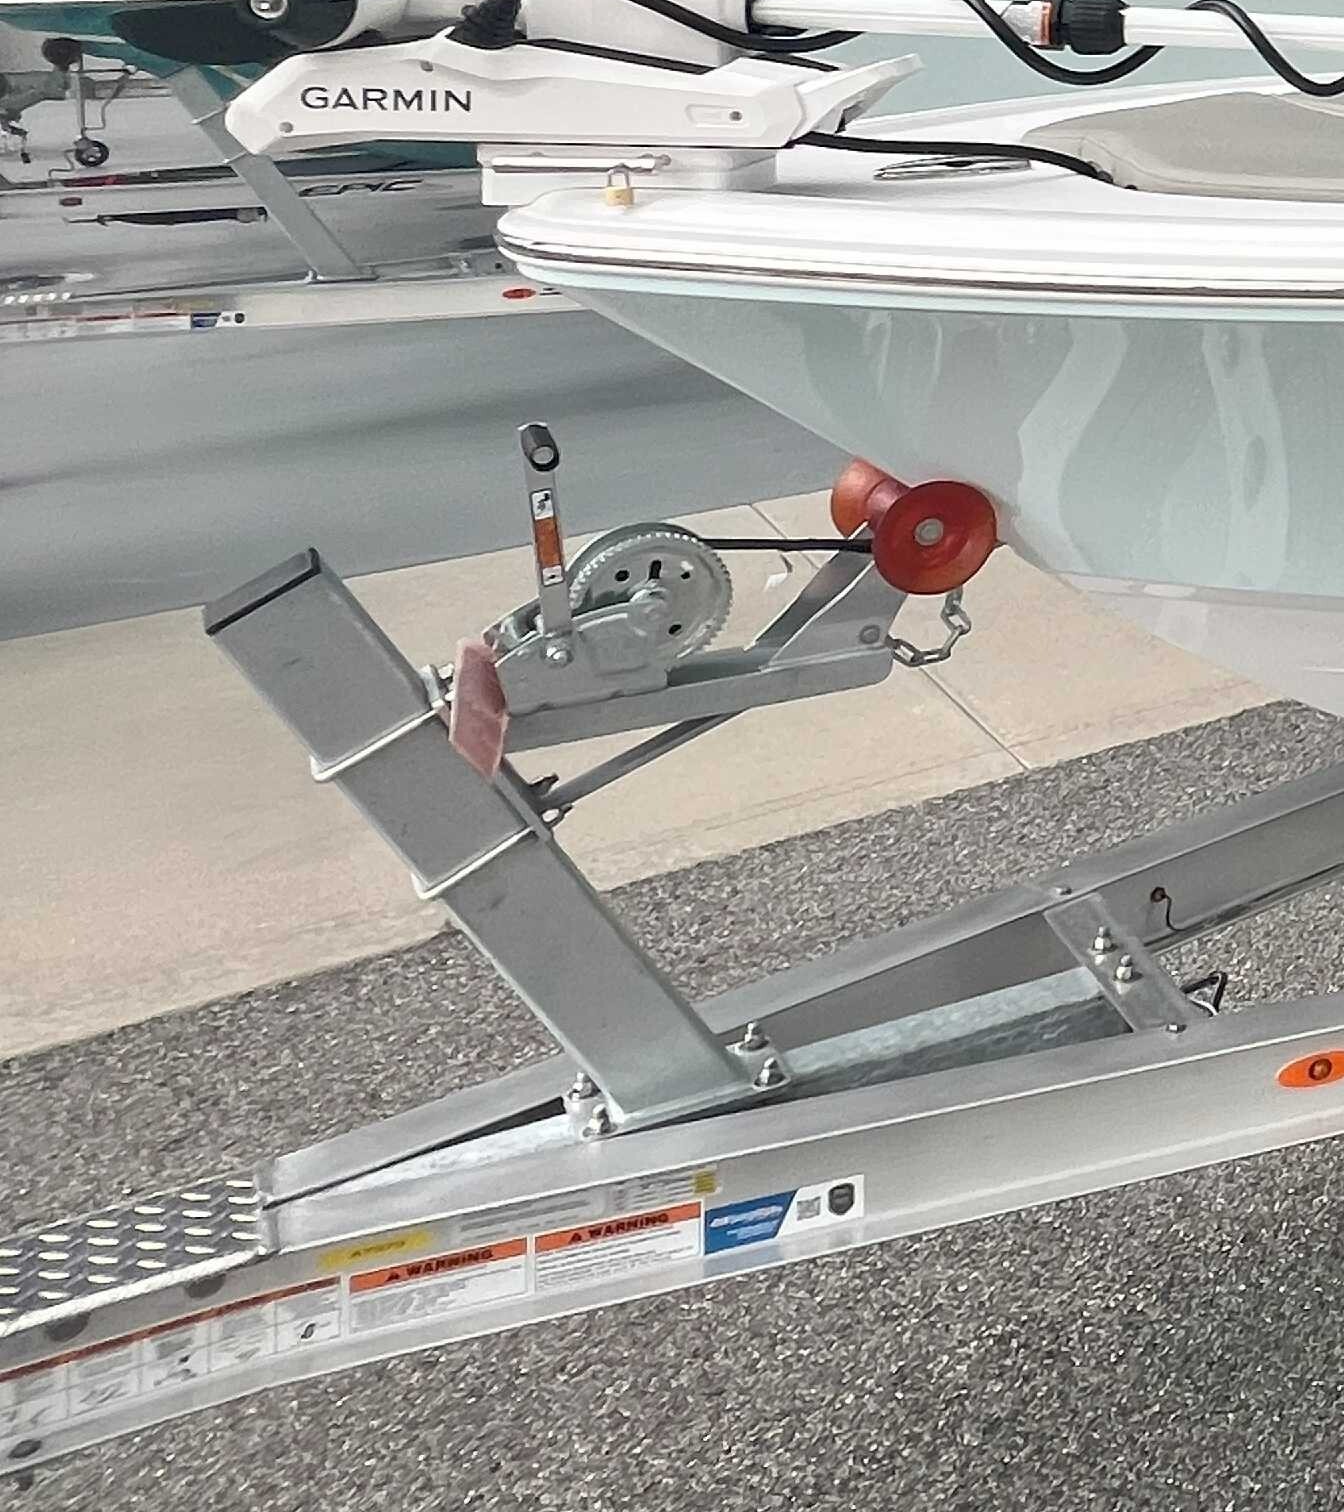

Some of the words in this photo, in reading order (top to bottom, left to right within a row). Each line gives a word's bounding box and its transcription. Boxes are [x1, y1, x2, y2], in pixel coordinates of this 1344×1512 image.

[300, 86, 472, 112] GARMIN
[588, 1213, 669, 1239] WARNING
[406, 1249, 494, 1277] WARNING
